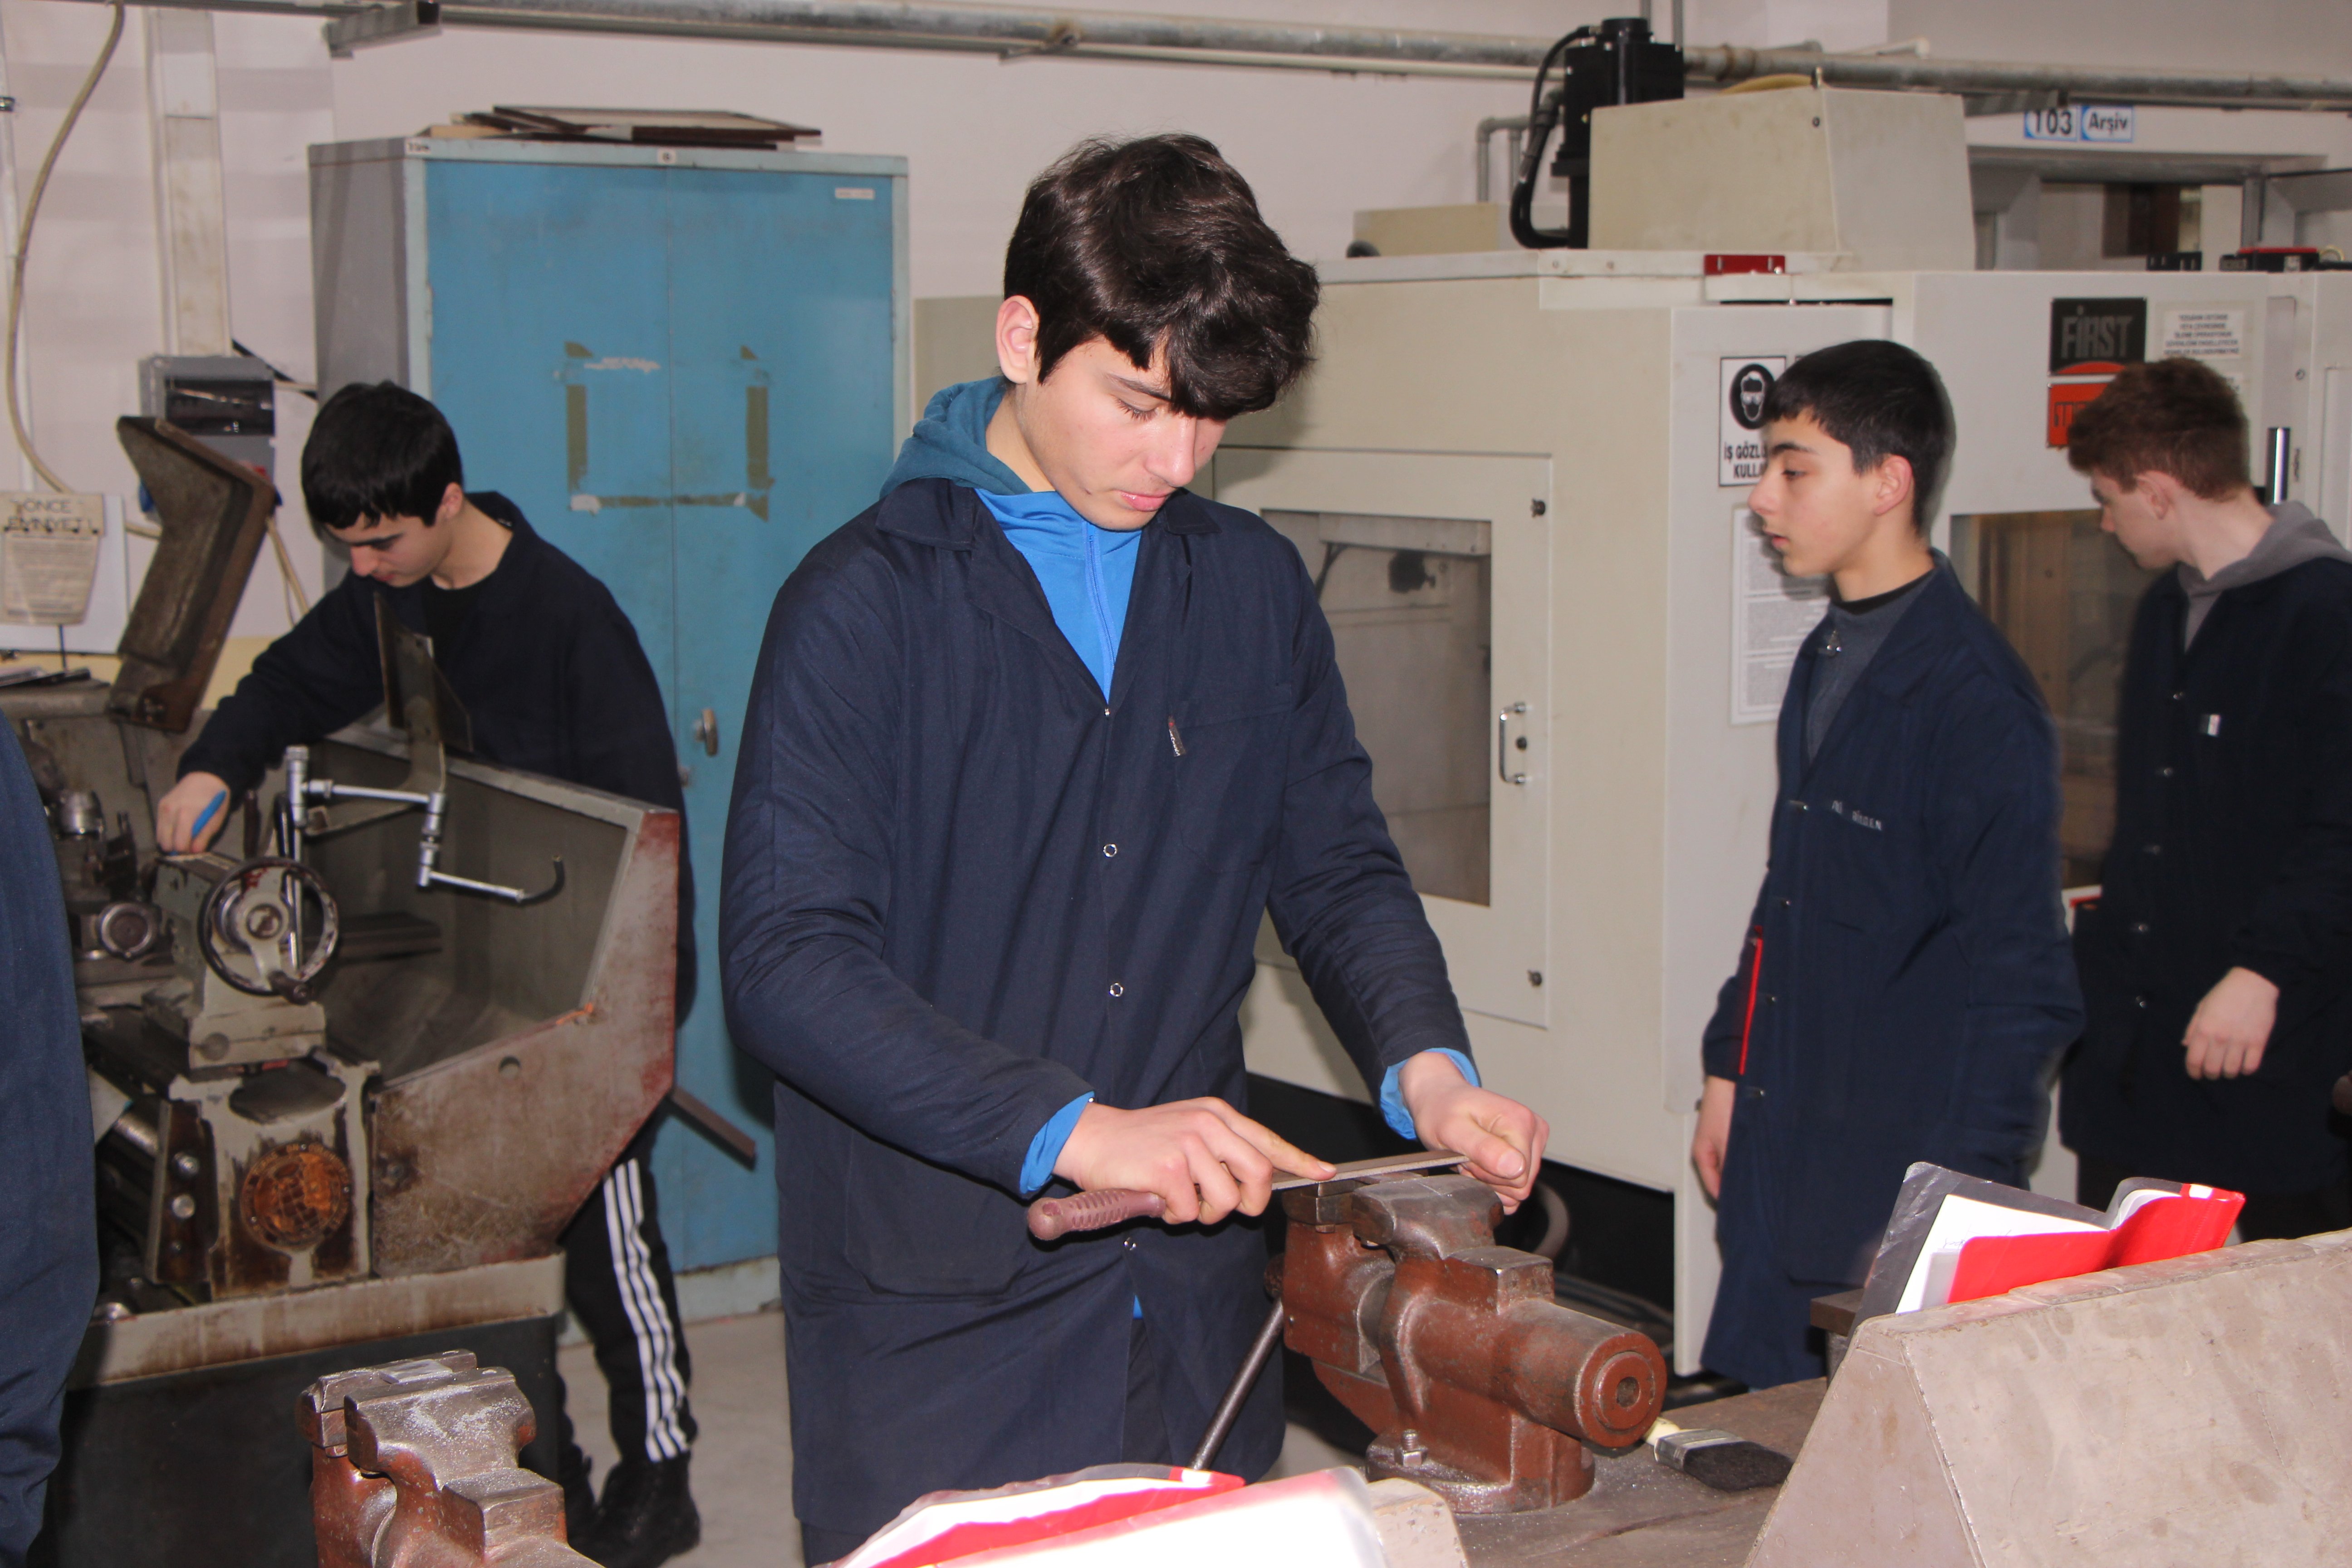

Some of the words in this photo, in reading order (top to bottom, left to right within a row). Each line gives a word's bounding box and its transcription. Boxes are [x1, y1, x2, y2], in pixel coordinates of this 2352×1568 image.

[2036, 108, 2072, 135] 103
[2090, 112, 2128, 134] Arşiv
[1724, 441, 1733, 462] İŞ
[24, 498, 72, 513] ÖNCE
